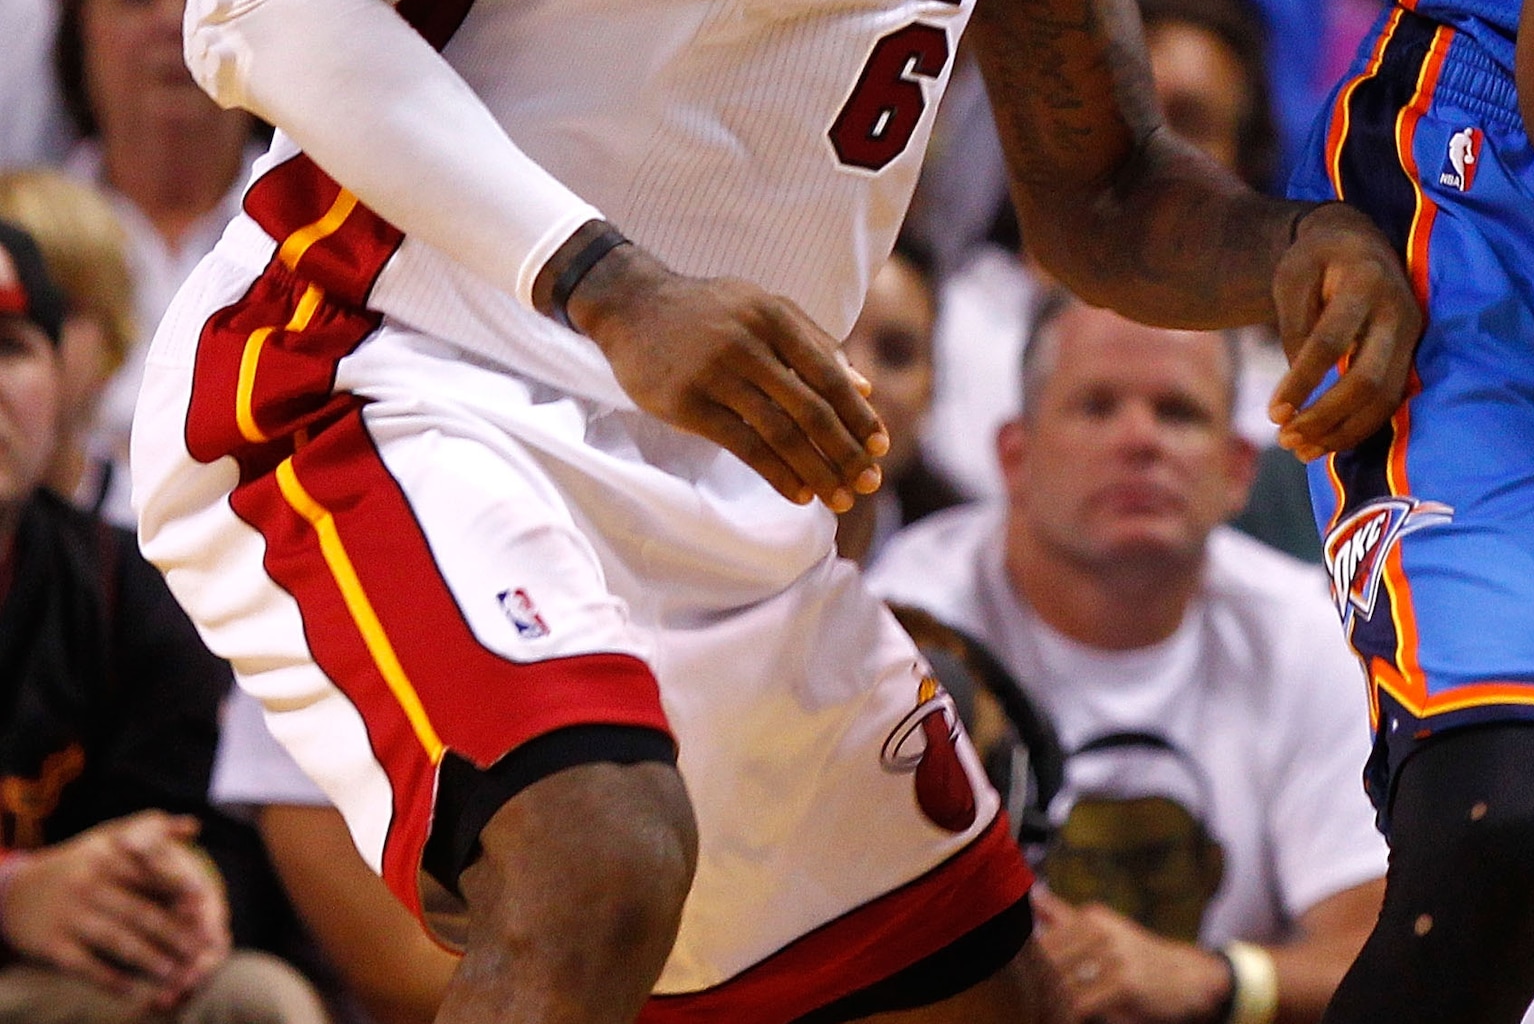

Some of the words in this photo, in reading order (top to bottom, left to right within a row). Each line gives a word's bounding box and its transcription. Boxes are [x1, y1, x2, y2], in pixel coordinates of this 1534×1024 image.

[826, 20, 950, 172] 6
[1440, 173, 1460, 188] NBA
[1333, 511, 1388, 621] OKC
